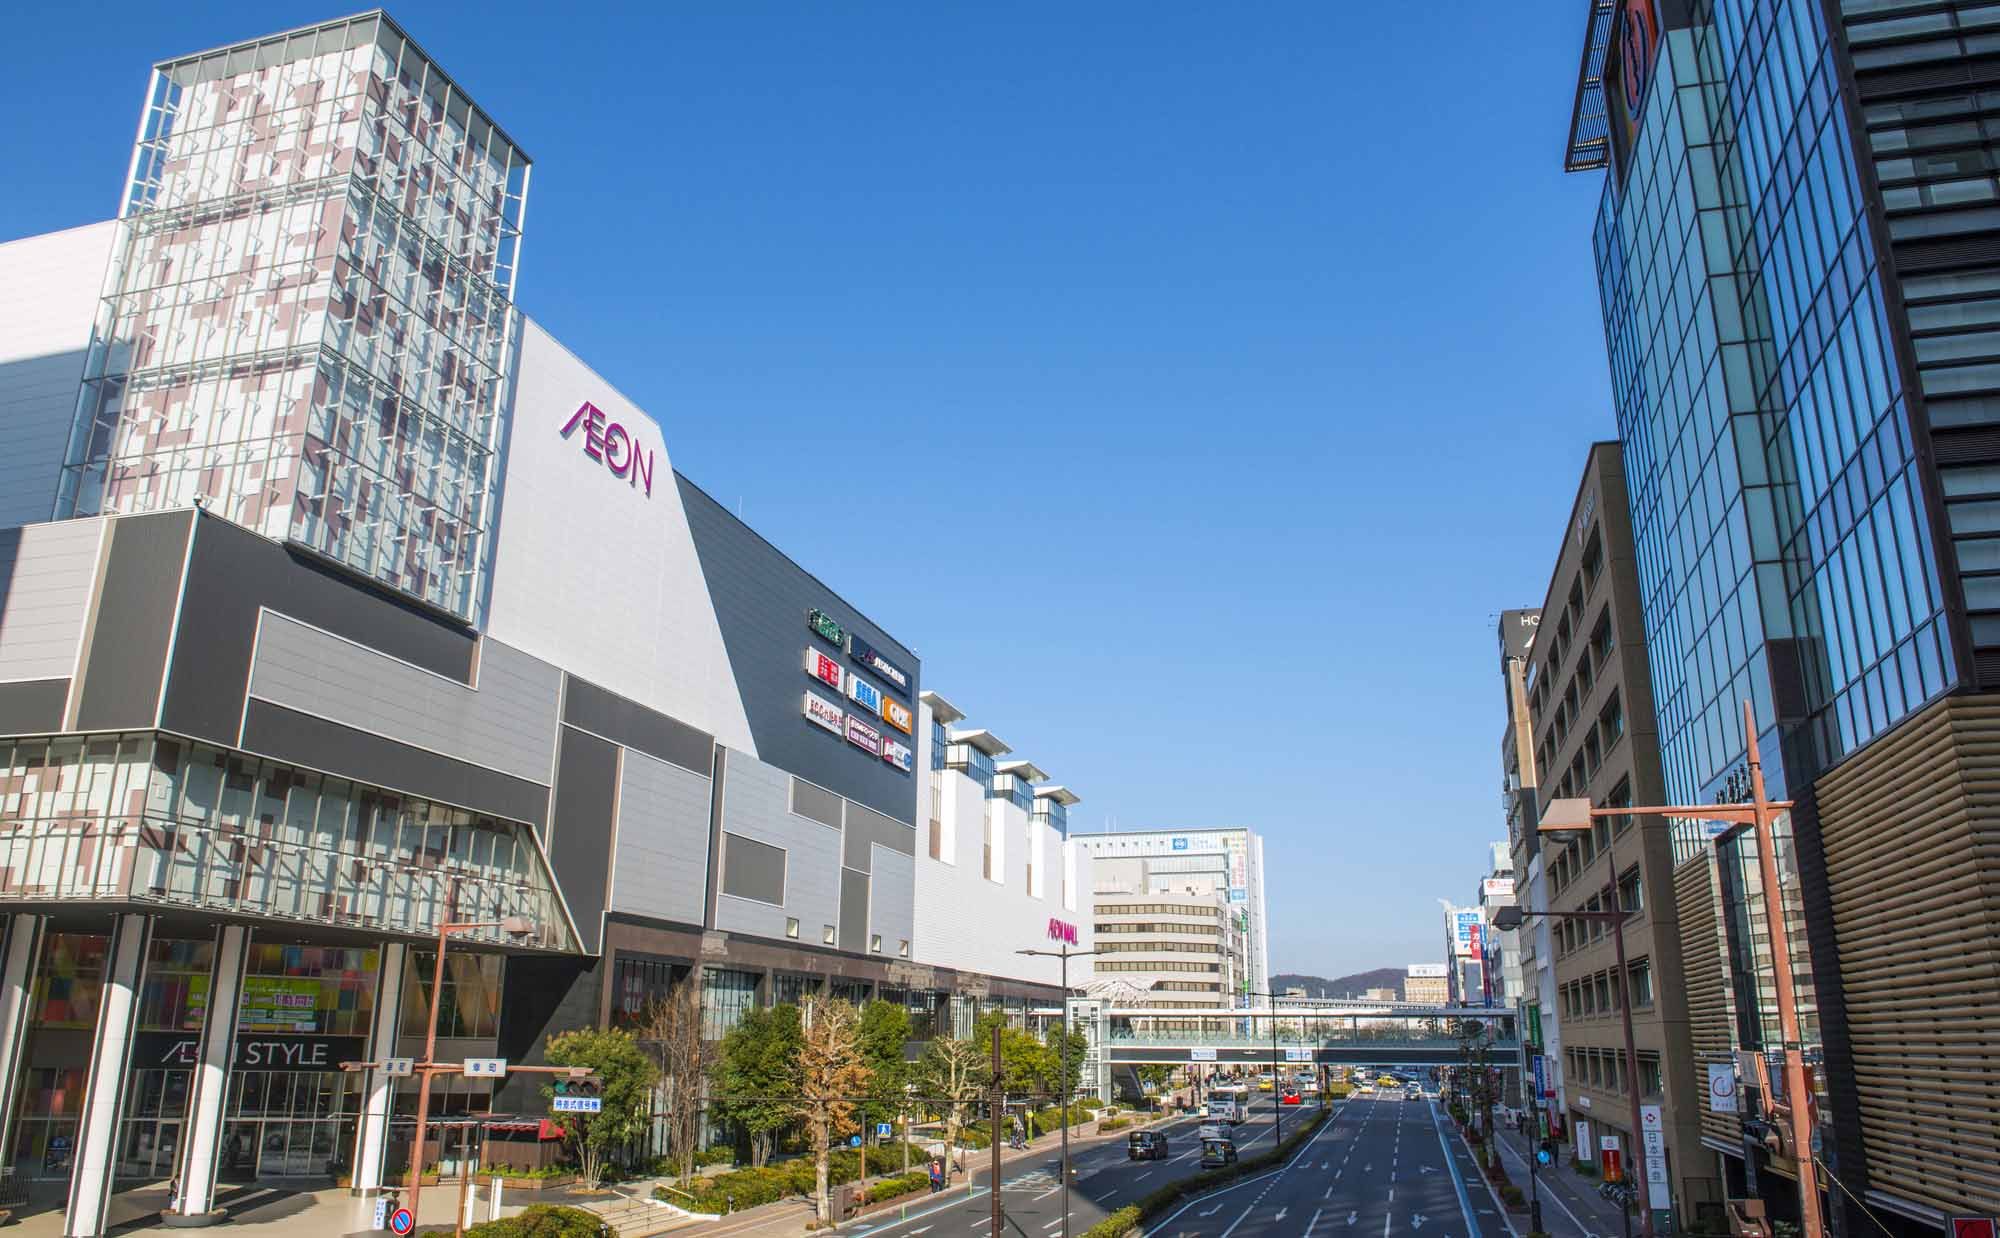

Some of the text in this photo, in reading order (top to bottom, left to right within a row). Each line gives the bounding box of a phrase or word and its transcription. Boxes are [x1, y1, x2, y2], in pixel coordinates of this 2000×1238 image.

[855, 680, 878, 709] SEGA
[244, 1041, 328, 1065] STYLE
[1647, 1132, 1662, 1181] 日本生命
